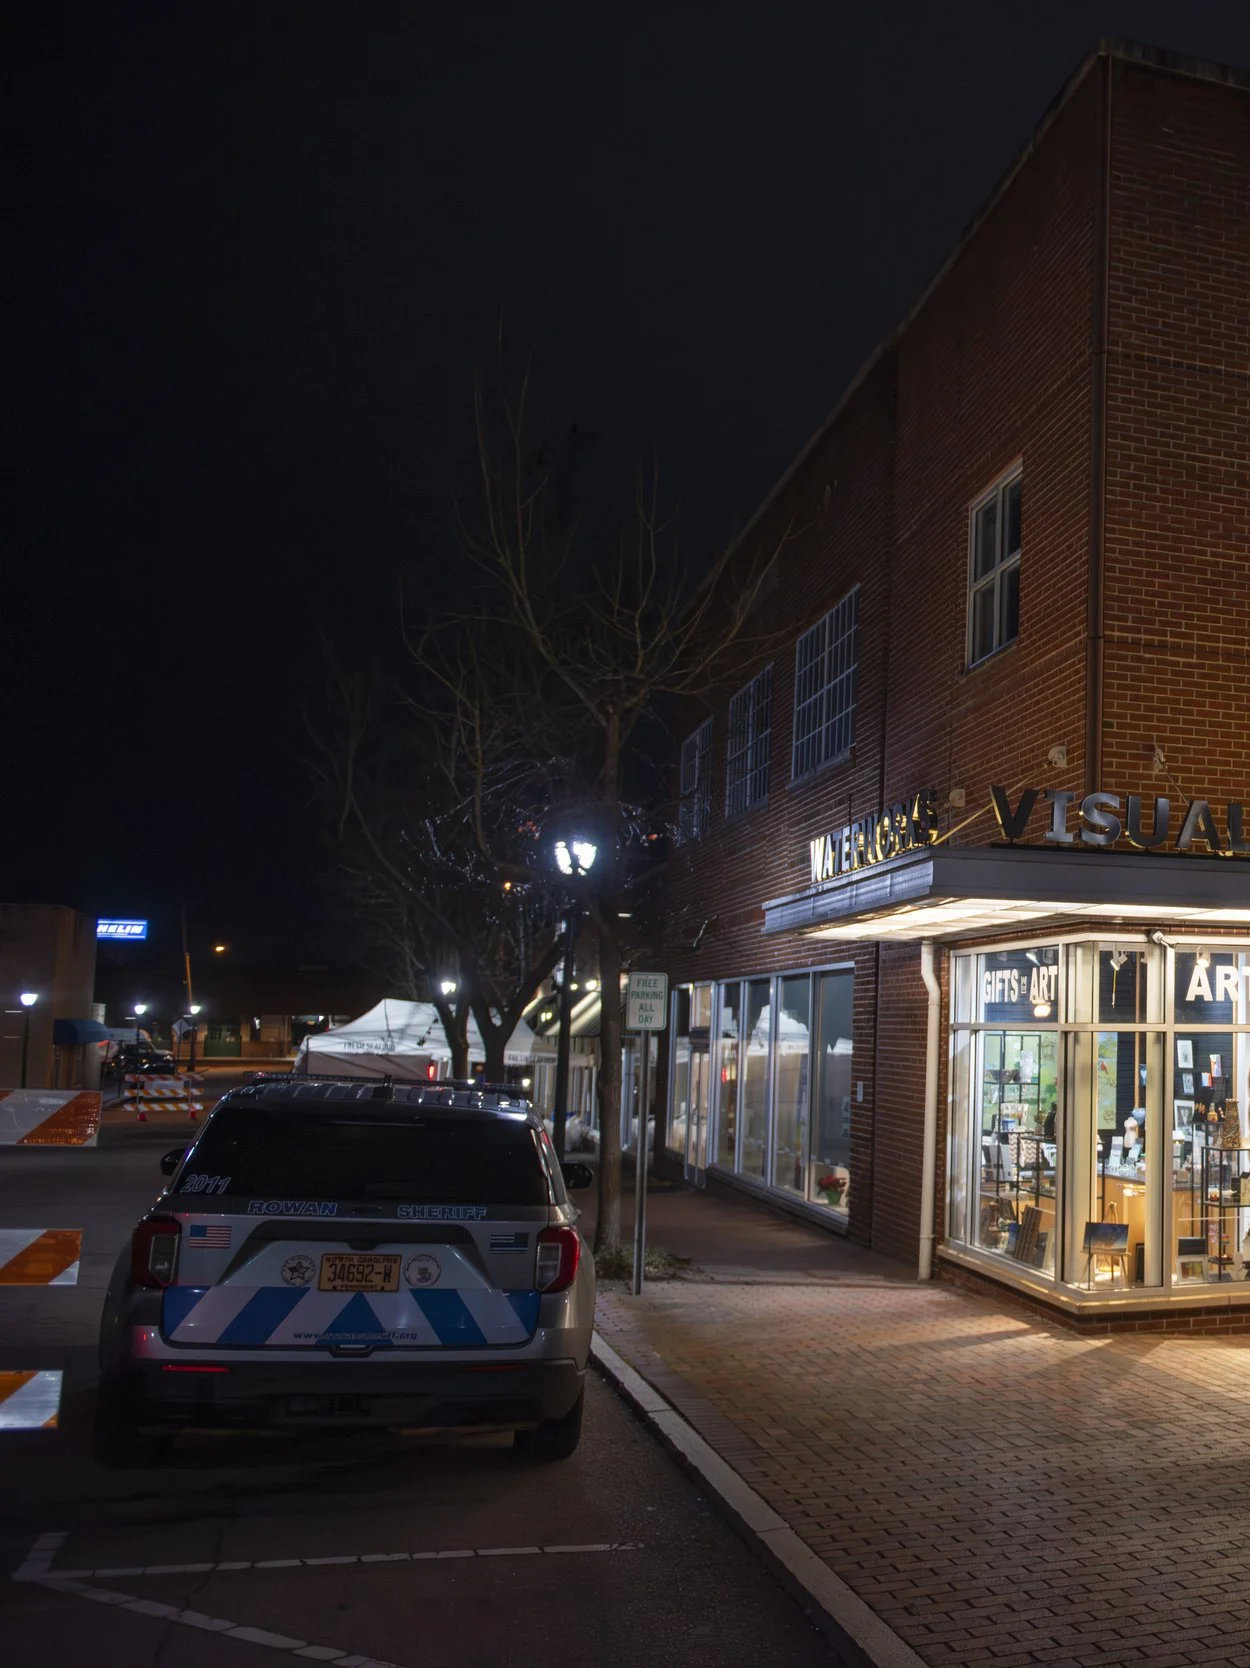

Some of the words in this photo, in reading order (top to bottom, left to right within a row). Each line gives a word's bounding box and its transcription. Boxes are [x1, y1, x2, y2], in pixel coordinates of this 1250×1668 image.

[810, 789, 938, 882] WATERWORKS
[636, 978, 658, 988] FREE
[984, 968, 1019, 1003] GIFTS
[1029, 965, 1058, 1001] ART
[631, 990, 664, 1000] PARKING
[638, 1003, 655, 1012] ALL
[638, 1014, 653, 1024] DAY
[180, 1174, 232, 1195] 2011
[247, 1200, 338, 1216] ROWAN
[397, 1205, 488, 1220] SHERIFF
[293, 1331, 418, 1341] www.iff.org
